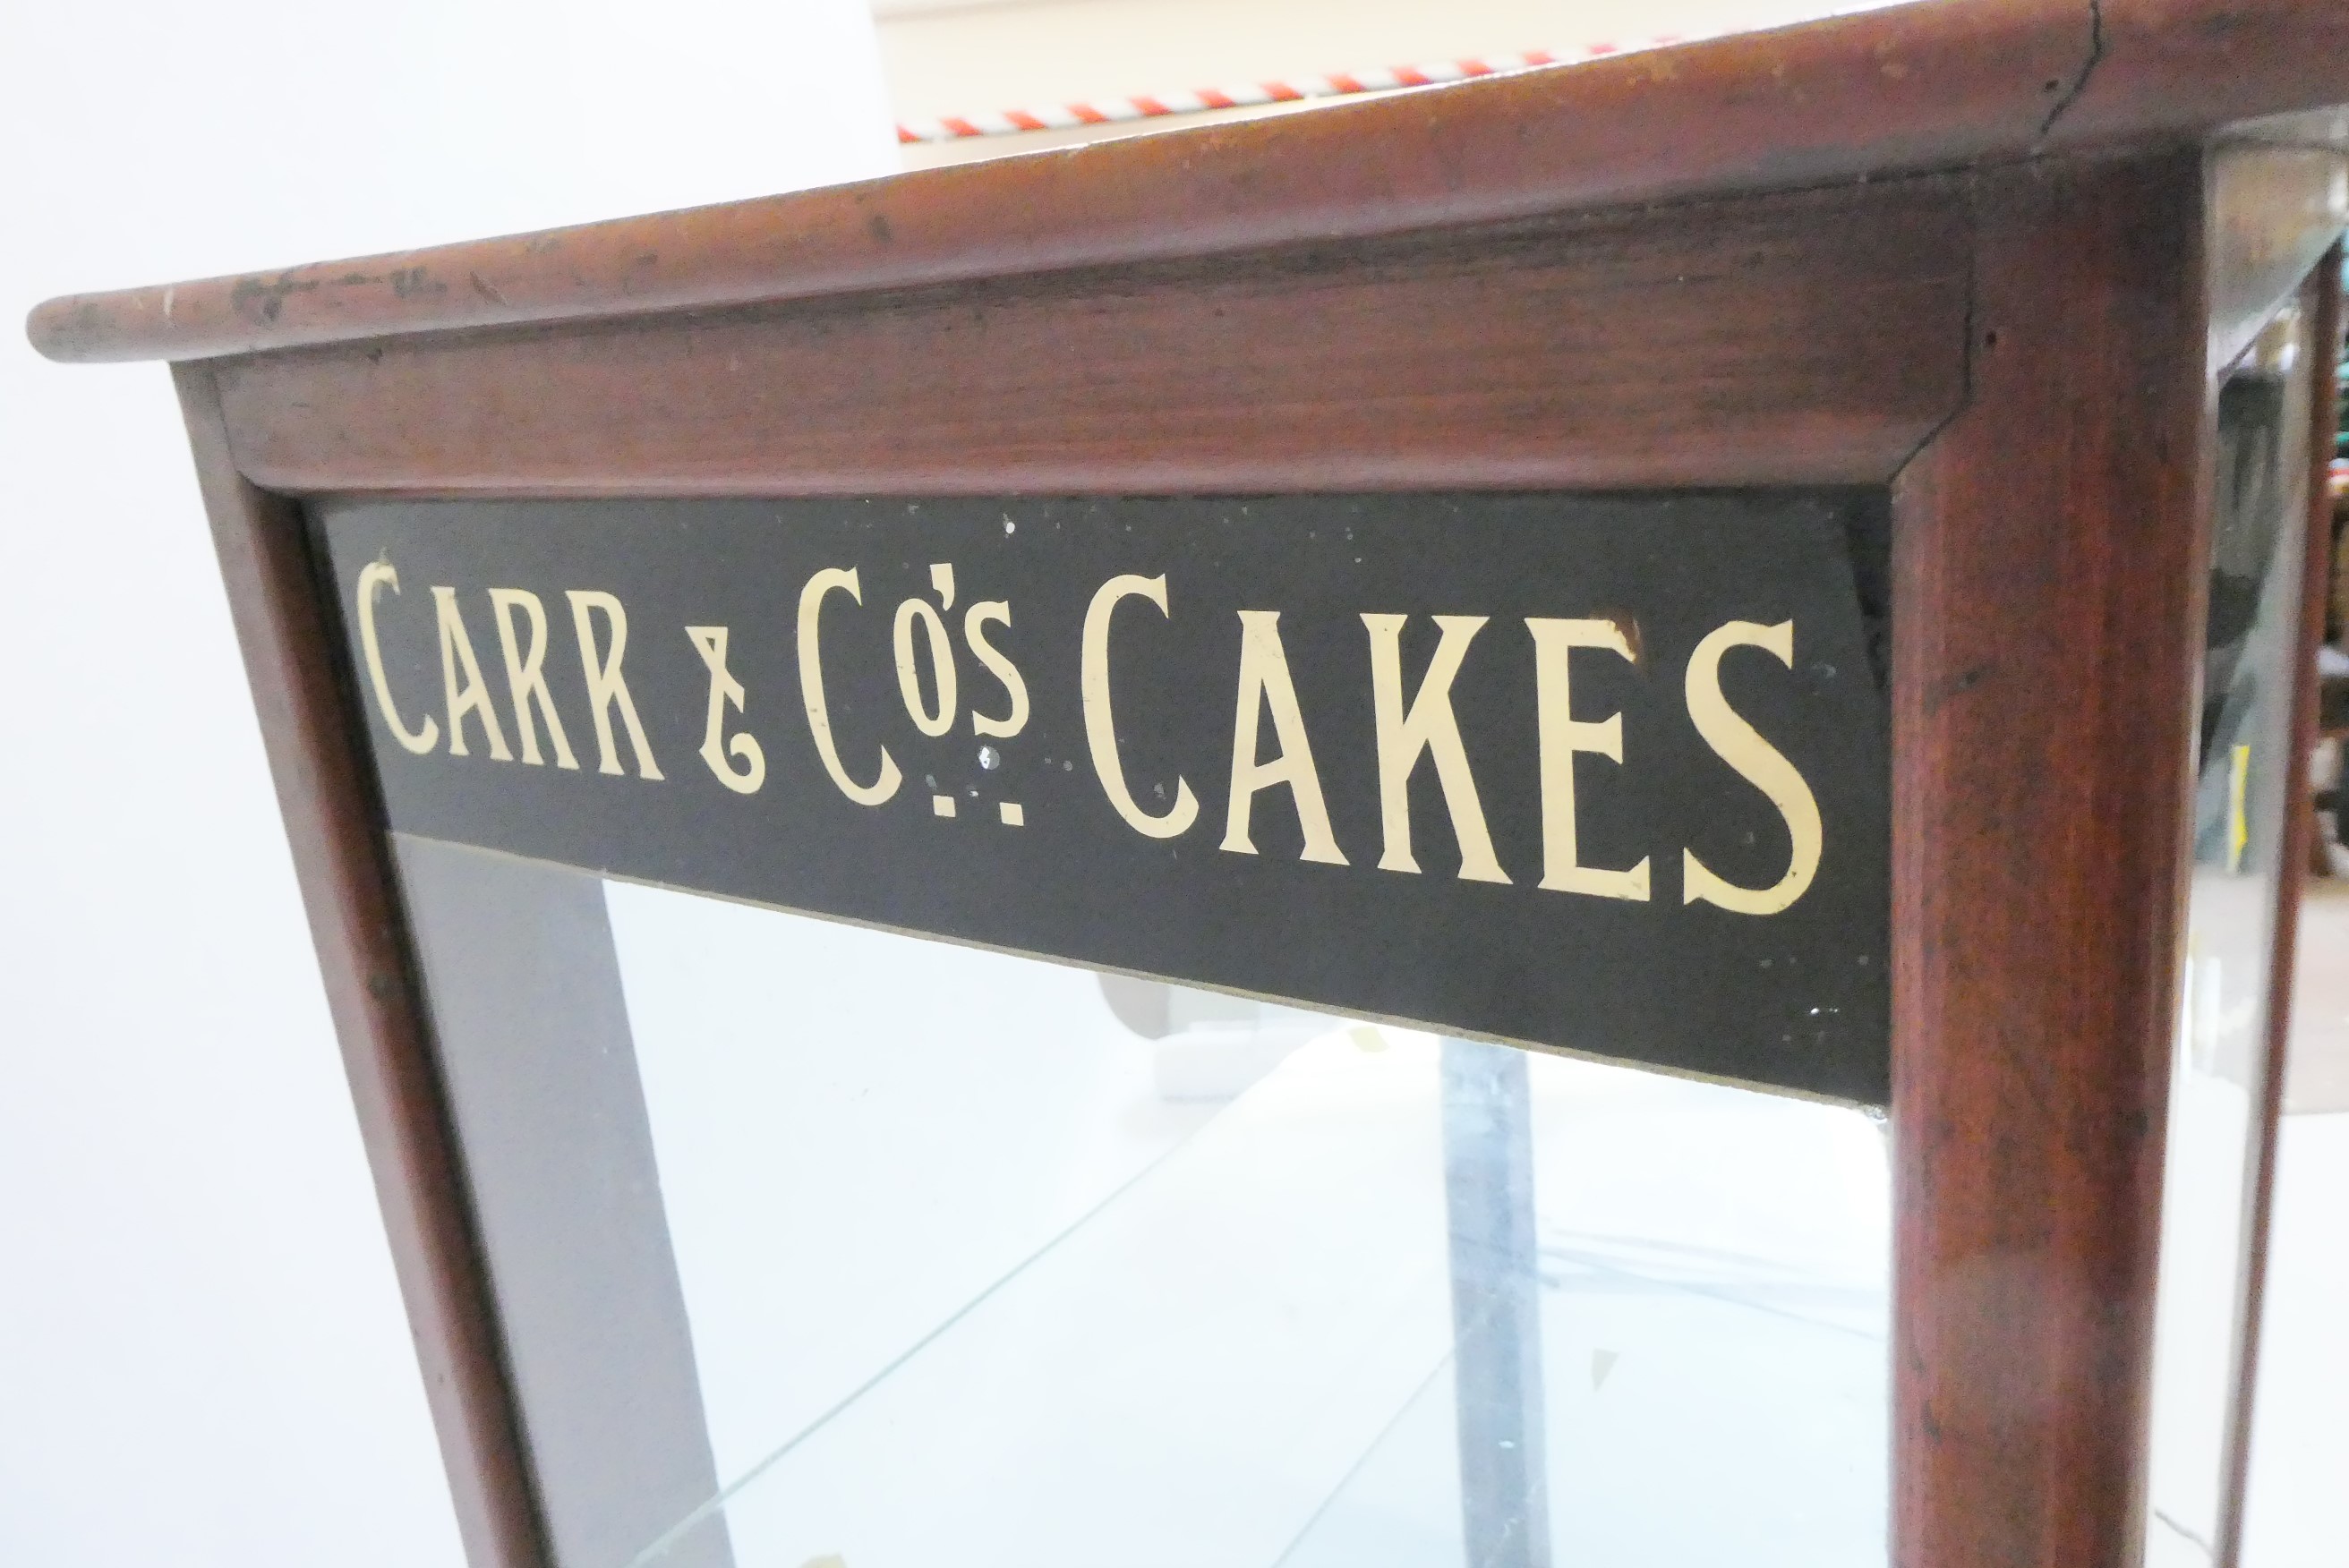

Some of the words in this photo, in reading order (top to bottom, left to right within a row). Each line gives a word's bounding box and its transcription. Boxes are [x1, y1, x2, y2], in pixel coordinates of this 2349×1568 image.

[355, 560, 665, 781] CARR
[684, 626, 765, 795] &
[1081, 574, 1823, 915] CAKES
